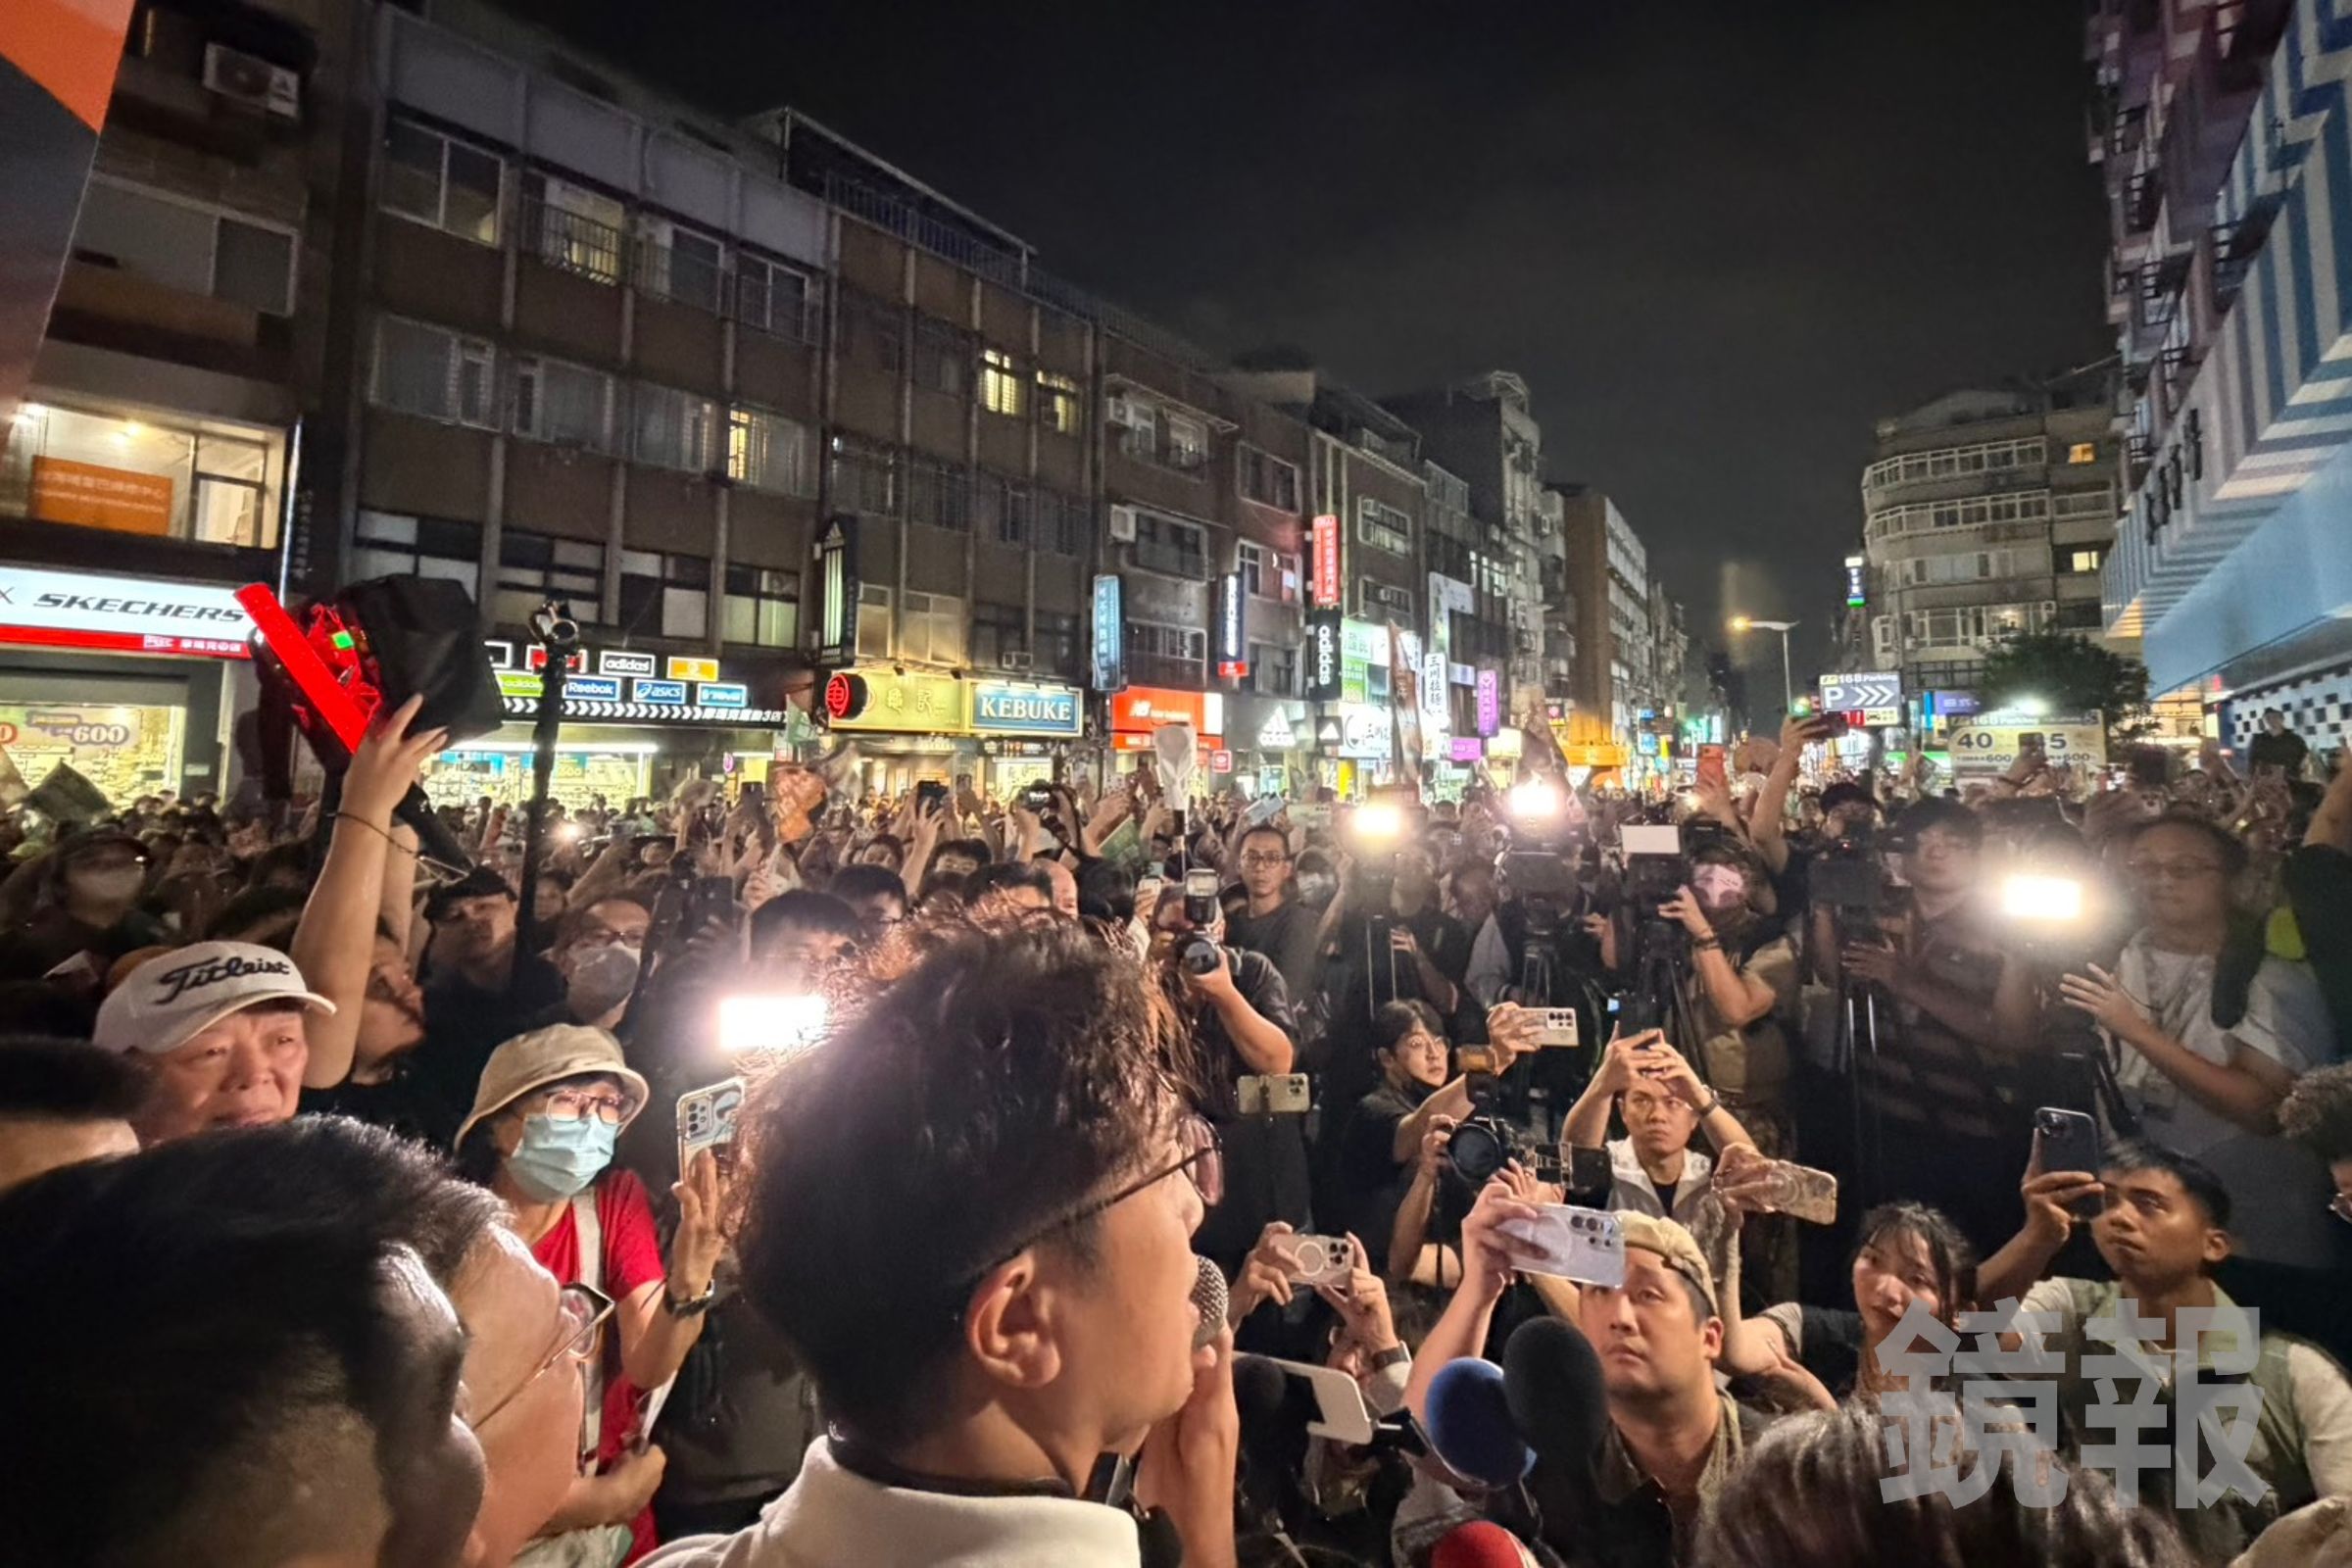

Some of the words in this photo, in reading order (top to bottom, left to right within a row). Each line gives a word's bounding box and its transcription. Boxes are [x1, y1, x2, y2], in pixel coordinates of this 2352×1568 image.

[33, 593, 245, 622] SKECHERS
[1318, 625, 1334, 685] adidas
[606, 658, 650, 671] adidas
[567, 682, 614, 695] Reebok
[651, 686, 681, 698] asics
[1825, 687, 1844, 709] P
[981, 696, 1072, 721] KEBUKE
[73, 725, 125, 743] 600
[1957, 732, 1993, 750] 40
[1986, 754, 2012, 762] 600
[153, 956, 291, 1006] Titleist
